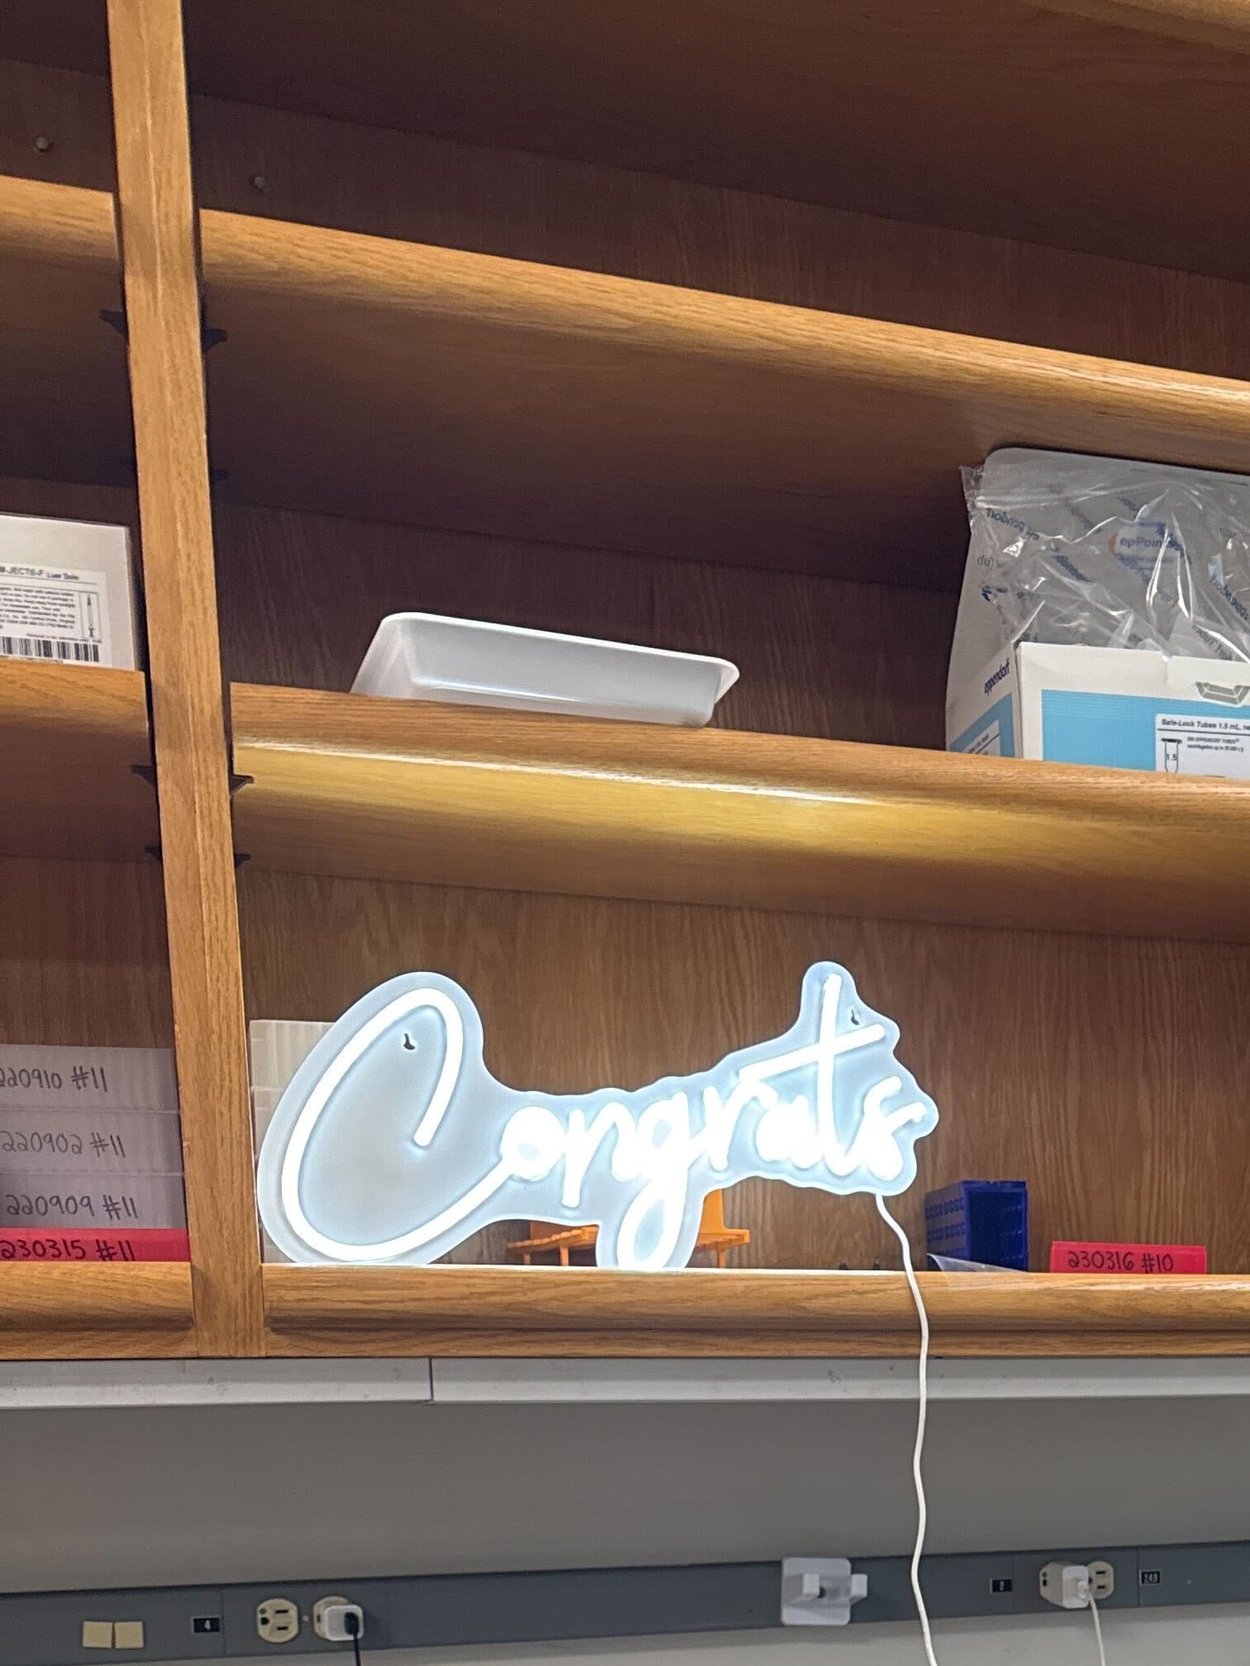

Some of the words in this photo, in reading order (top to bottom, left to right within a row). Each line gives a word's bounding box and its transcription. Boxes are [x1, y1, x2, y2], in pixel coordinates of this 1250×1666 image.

[71, 1066, 108, 1092] #11
[281, 973, 928, 1270] Congrats
[2, 1130, 82, 1156] 220902
[90, 1132, 126, 1158] #11
[6, 1194, 95, 1217] 220909
[103, 1194, 138, 1220] #11
[1, 1238, 87, 1260] 230315
[95, 1239, 136, 1261] #11
[1068, 1250, 1134, 1271] 230316
[1141, 1253, 1174, 1274] #10
